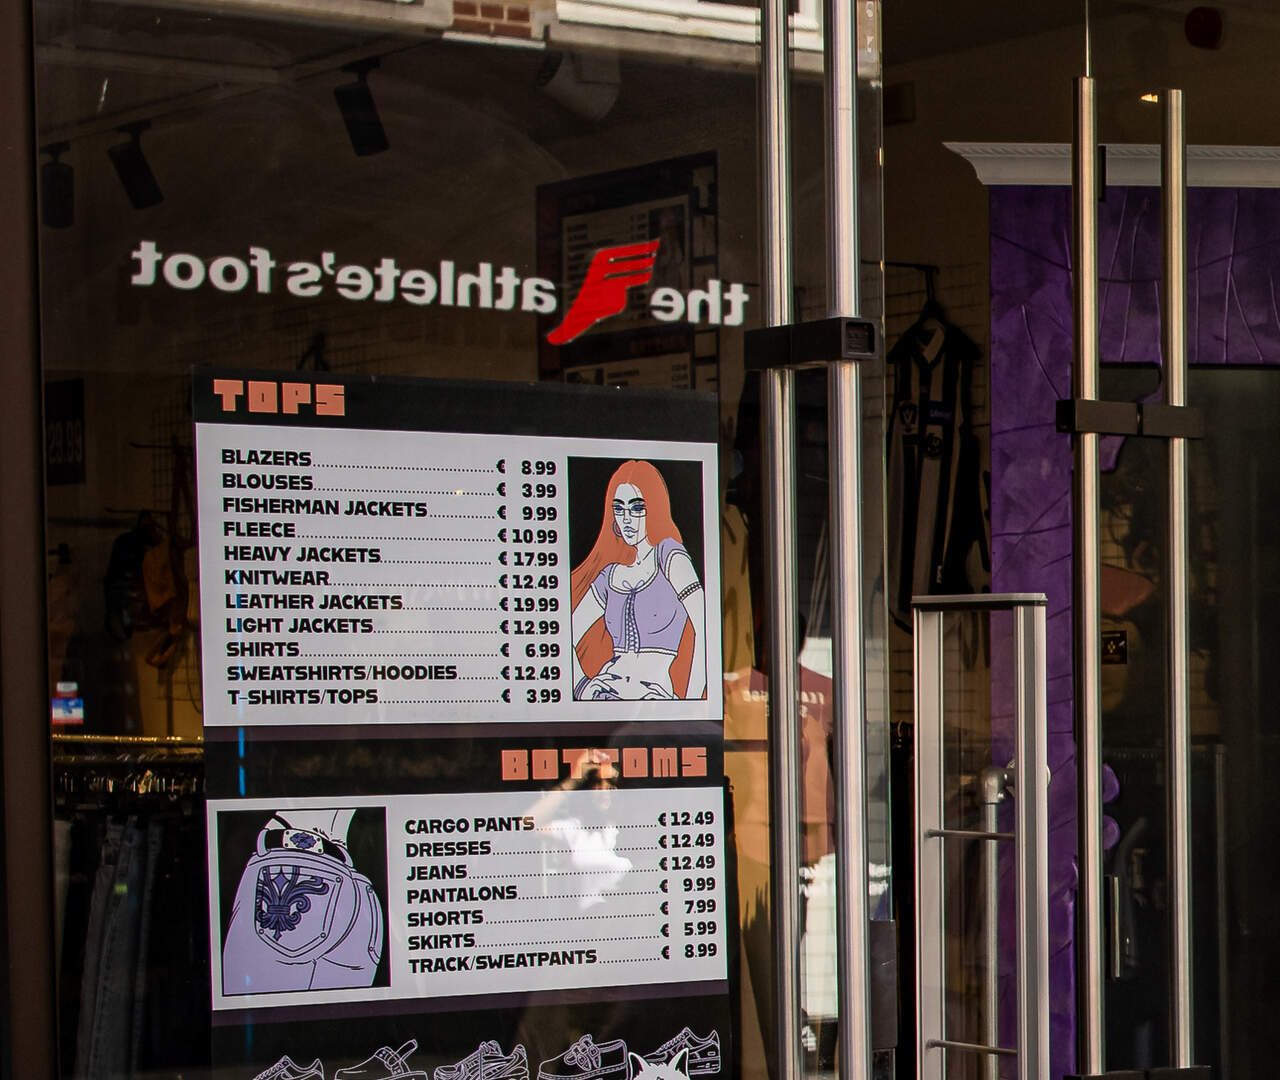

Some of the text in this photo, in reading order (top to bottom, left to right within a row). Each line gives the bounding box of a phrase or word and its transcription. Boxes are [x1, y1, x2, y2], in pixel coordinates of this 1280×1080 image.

[213, 379, 345, 416] TOPS
[221, 448, 311, 466] BLAZERS
[521, 460, 556, 475] 8.99
[222, 473, 313, 490] BLOUSES
[522, 483, 557, 498] 3.99
[222, 497, 339, 514] FISHERMAN
[344, 500, 427, 517] JACKETS
[522, 506, 557, 521] 9.99
[224, 521, 295, 537] FLEECE
[512, 529, 558, 544] 10.99
[224, 546, 291, 561] HEAVY
[296, 547, 381, 562] JACKETS
[514, 552, 558, 566] 17.99
[224, 570, 329, 585] KNITWEAR
[512, 574, 559, 589] 12.49
[225, 594, 314, 609] LEATHER
[318, 595, 402, 609] JACKETS
[514, 597, 559, 612] 19.99
[226, 618, 283, 633] LIGHT
[288, 618, 373, 633] JACKETS
[514, 620, 560, 635] 12.99
[226, 642, 300, 657] SHIRTS
[525, 643, 560, 657] 6.99
[227, 665, 457, 681] SWEATSHIRTS/HOODIES
[514, 666, 561, 680] 12.49
[227, 689, 378, 704] T-SHIRTS/TOPS
[526, 689, 561, 703] 3.99
[501, 747, 707, 780] BOTTOMS
[405, 818, 469, 834] CARGO
[474, 816, 535, 832] PANTS
[671, 811, 715, 826] 12.49
[405, 841, 491, 857] DRESSES
[671, 833, 715, 848] 12.49
[406, 864, 467, 881] JEANS
[672, 855, 716, 870] 12.49
[407, 885, 517, 904] PANTALONS
[683, 877, 716, 892] 9.99
[407, 909, 484, 927] SHORTS
[684, 899, 716, 914] 7.99
[408, 933, 475, 950] SKIRTS
[684, 921, 717, 936] 5.99
[408, 949, 597, 973] TRACK/SWEATPANTS
[684, 943, 717, 958] 8.99
